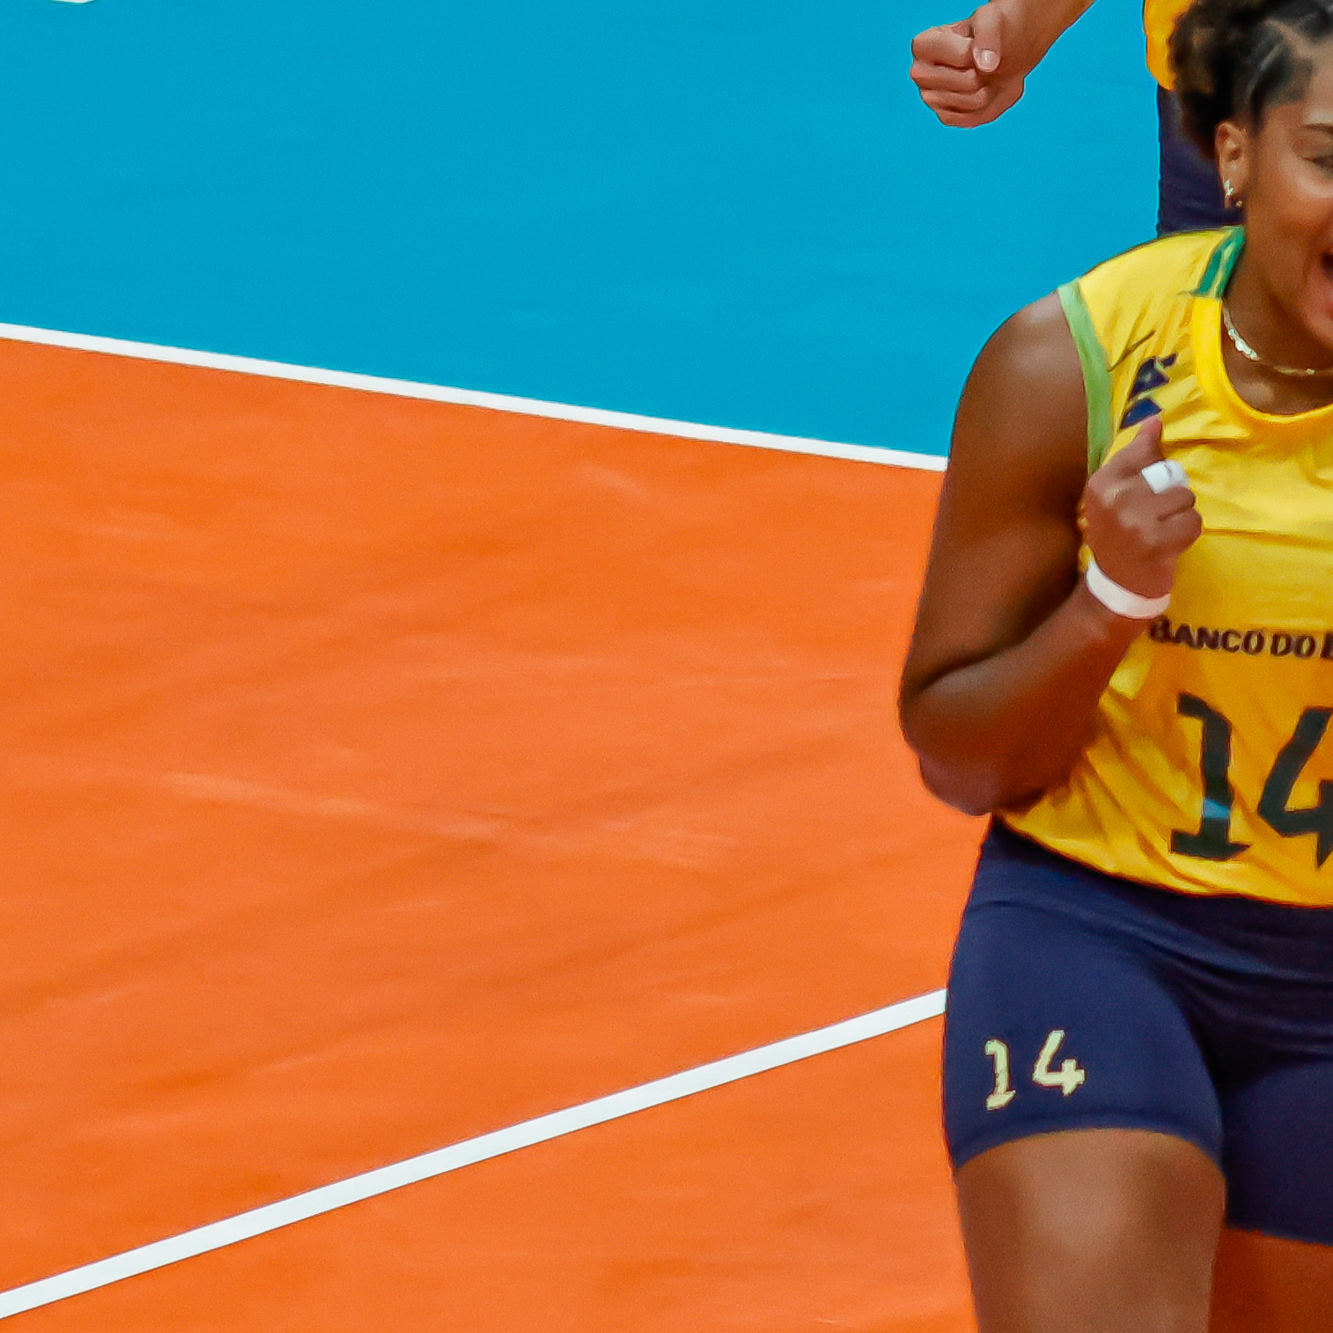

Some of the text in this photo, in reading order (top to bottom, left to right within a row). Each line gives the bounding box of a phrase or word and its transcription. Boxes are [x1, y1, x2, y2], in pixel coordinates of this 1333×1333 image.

[1149, 615, 1266, 656] BANCO
[1269, 631, 1316, 659] DO
[984, 1029, 1086, 1111] 14
